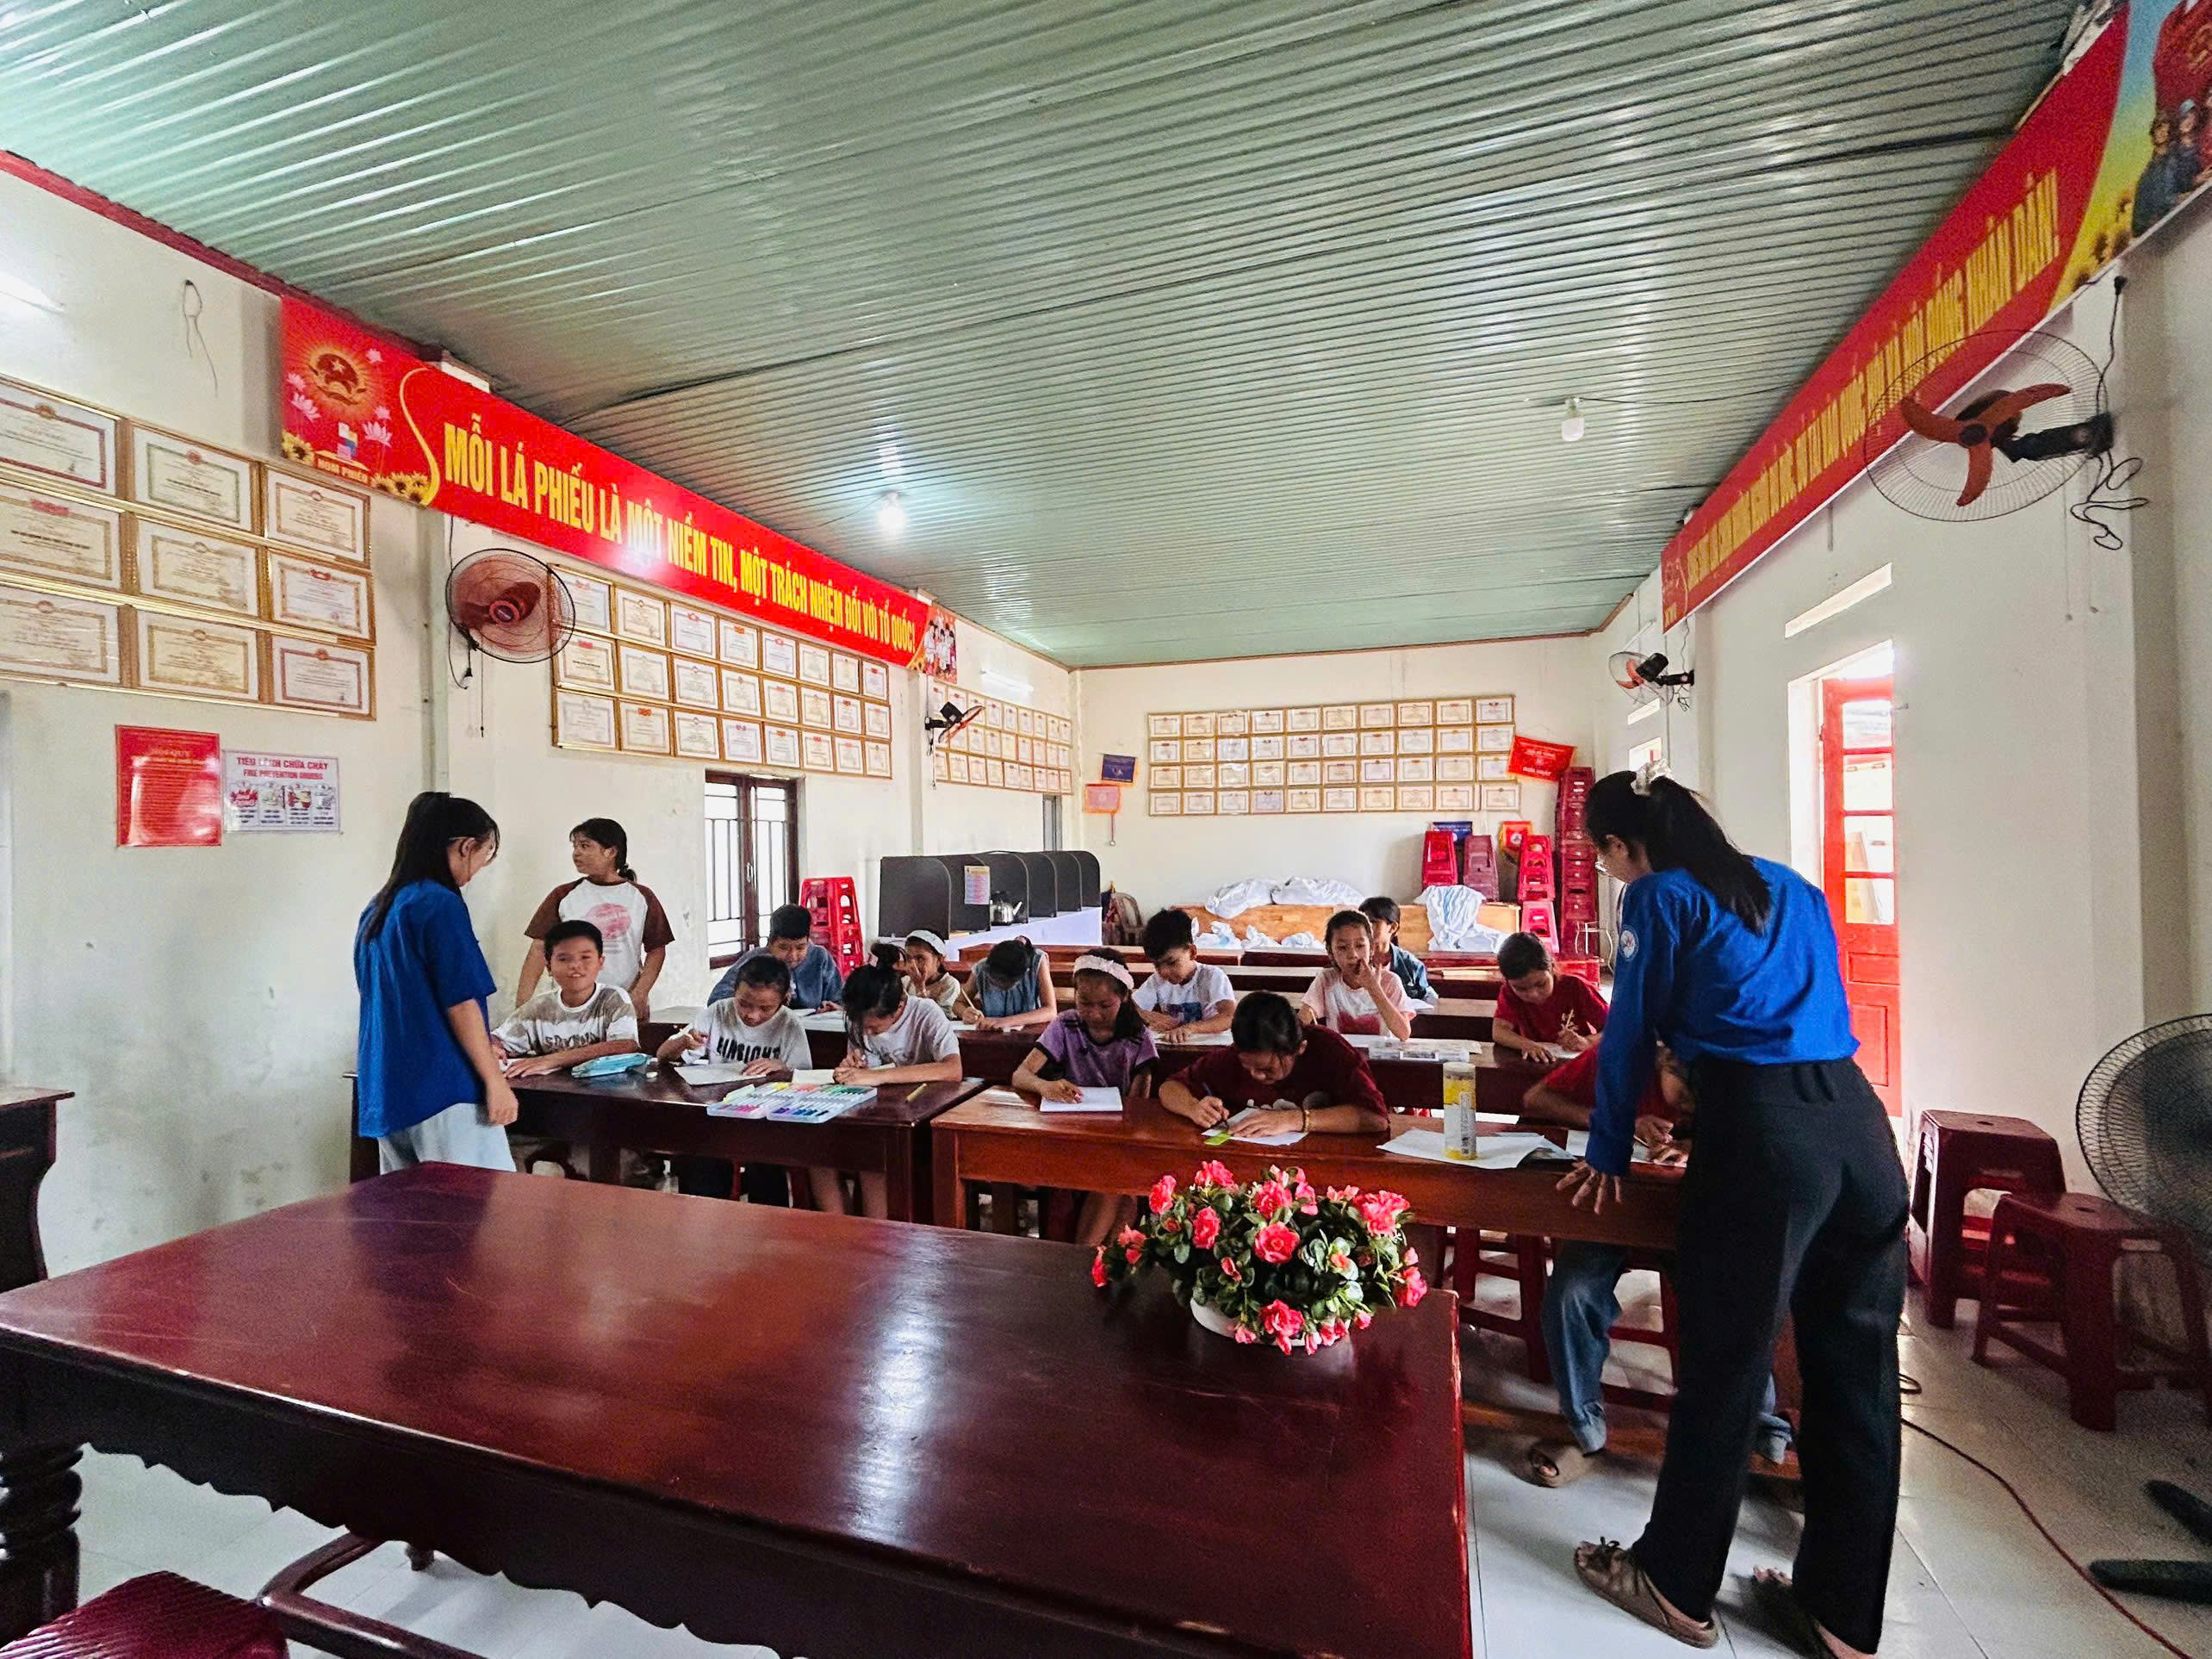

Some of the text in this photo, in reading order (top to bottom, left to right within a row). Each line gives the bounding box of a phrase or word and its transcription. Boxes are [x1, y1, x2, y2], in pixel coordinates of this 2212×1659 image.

[444, 413, 494, 497] MỖI
[500, 441, 529, 510] LÁ
[533, 462, 595, 534] PHIẾU
[599, 482, 623, 544] LÀ
[710, 536, 738, 593] TIN,
[741, 545, 767, 606] MỘT
[770, 562, 808, 616] TRÁCH
[809, 578, 843, 633] NHIỆM
[845, 586, 861, 634] ĐỐI
[862, 598, 878, 641] VỚI
[879, 600, 891, 645] TỔ
